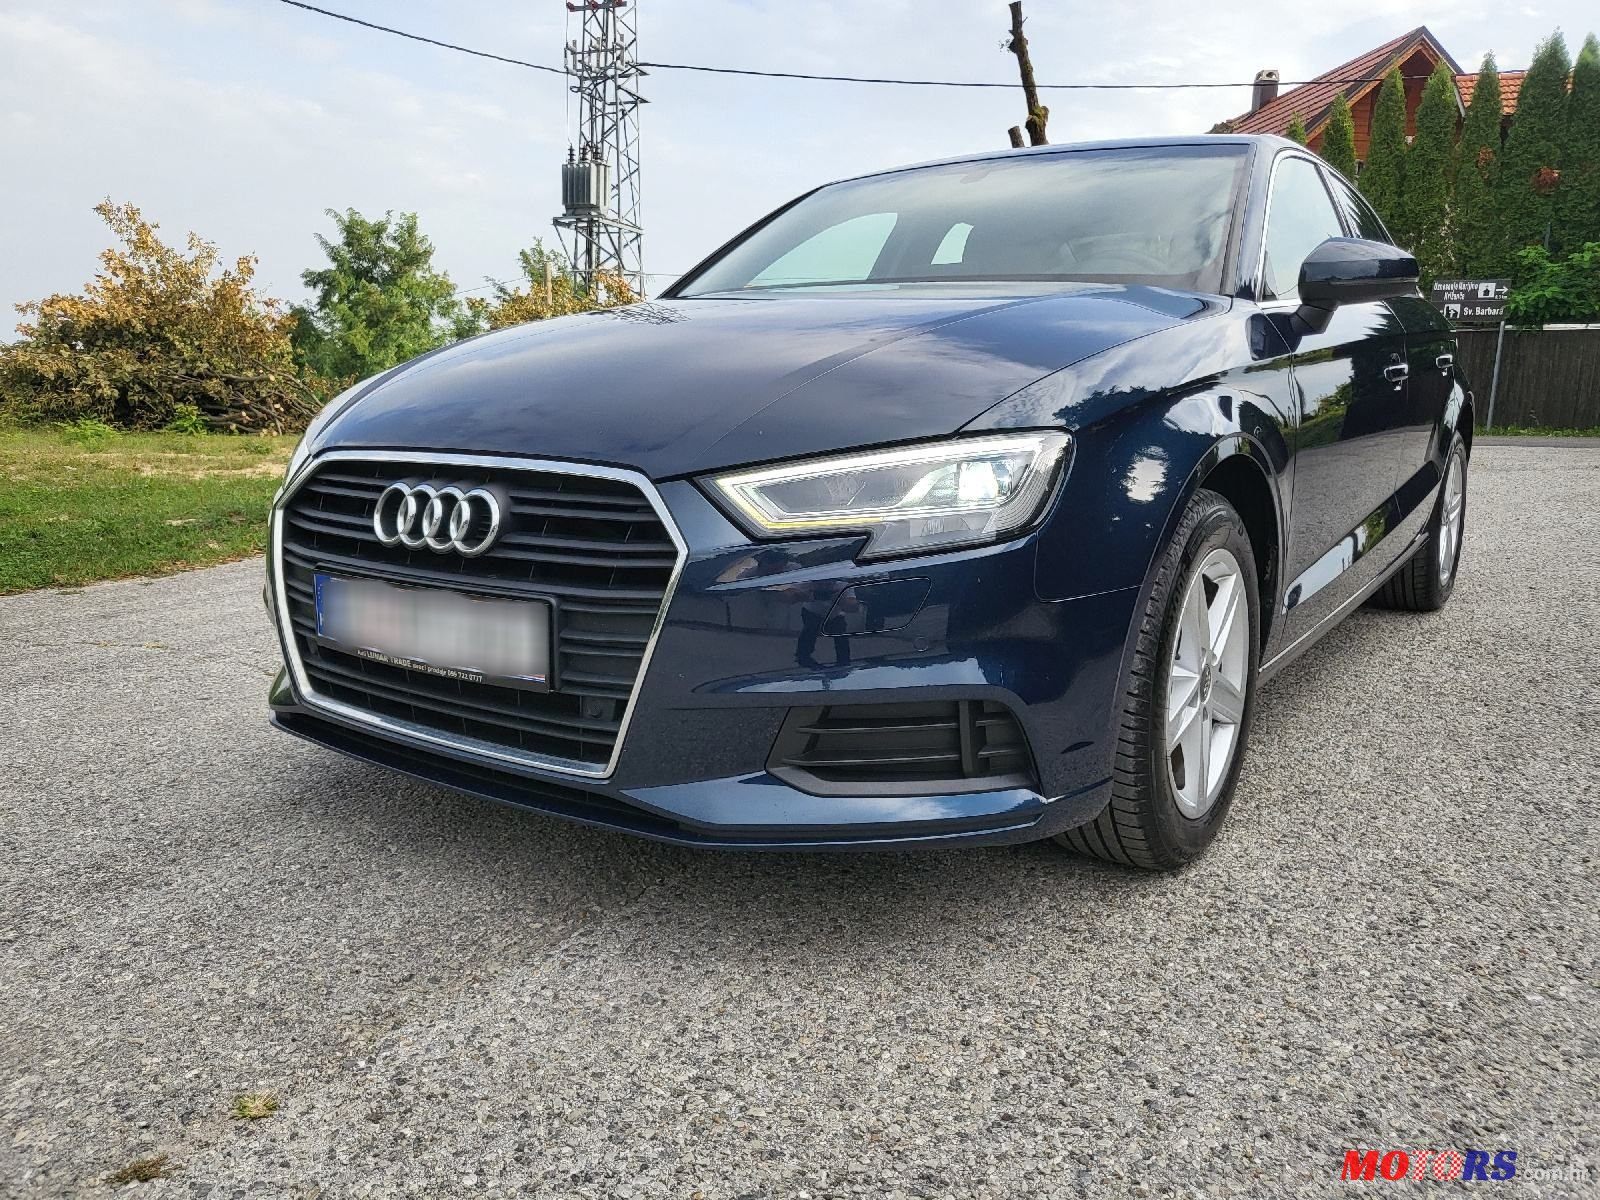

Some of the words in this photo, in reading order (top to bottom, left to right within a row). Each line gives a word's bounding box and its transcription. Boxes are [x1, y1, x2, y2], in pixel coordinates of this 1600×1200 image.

[1463, 306, 1474, 316] Sv.
[1475, 306, 1504, 316] Barbara
[390, 656, 412, 668] TRADE
